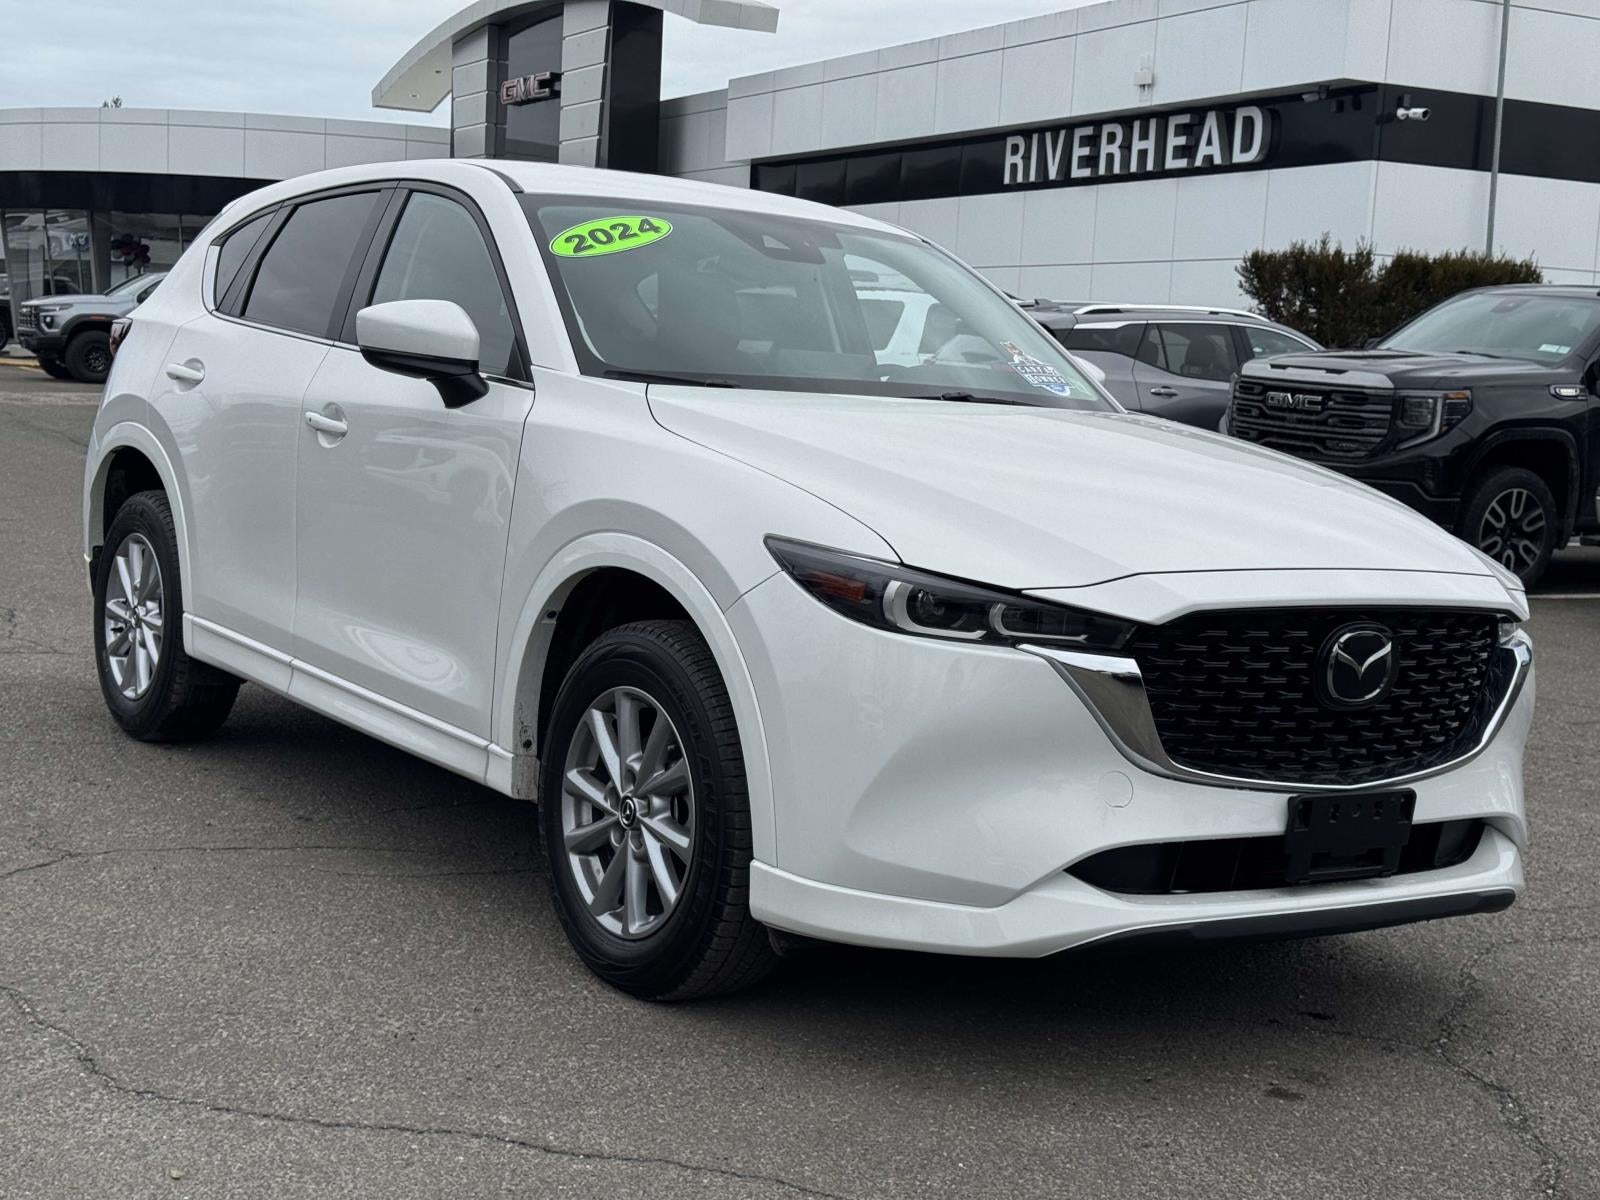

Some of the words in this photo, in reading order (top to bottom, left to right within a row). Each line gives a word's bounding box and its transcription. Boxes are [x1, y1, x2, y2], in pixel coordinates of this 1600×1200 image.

[501, 71, 550, 104] GMC
[1003, 105, 1266, 186] RIVERHEAD
[564, 217, 663, 254] 2024
[1265, 391, 1323, 412] GMC
